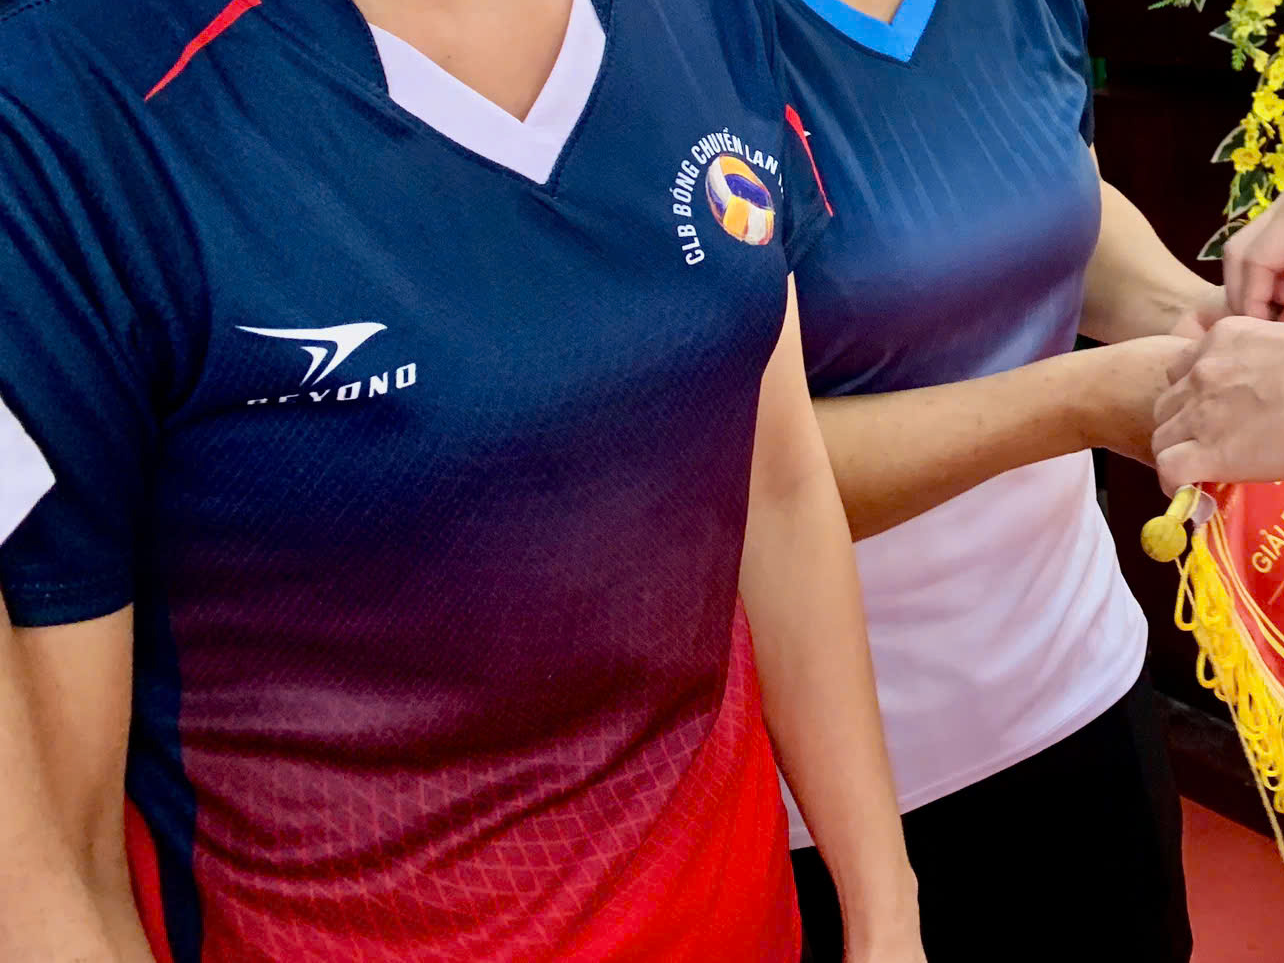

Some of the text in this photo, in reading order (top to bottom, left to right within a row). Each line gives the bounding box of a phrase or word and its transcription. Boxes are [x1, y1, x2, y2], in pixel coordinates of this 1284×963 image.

[745, 144, 778, 175] LAN
[669, 159, 700, 217] BÓNG
[677, 224, 705, 266] CLB
